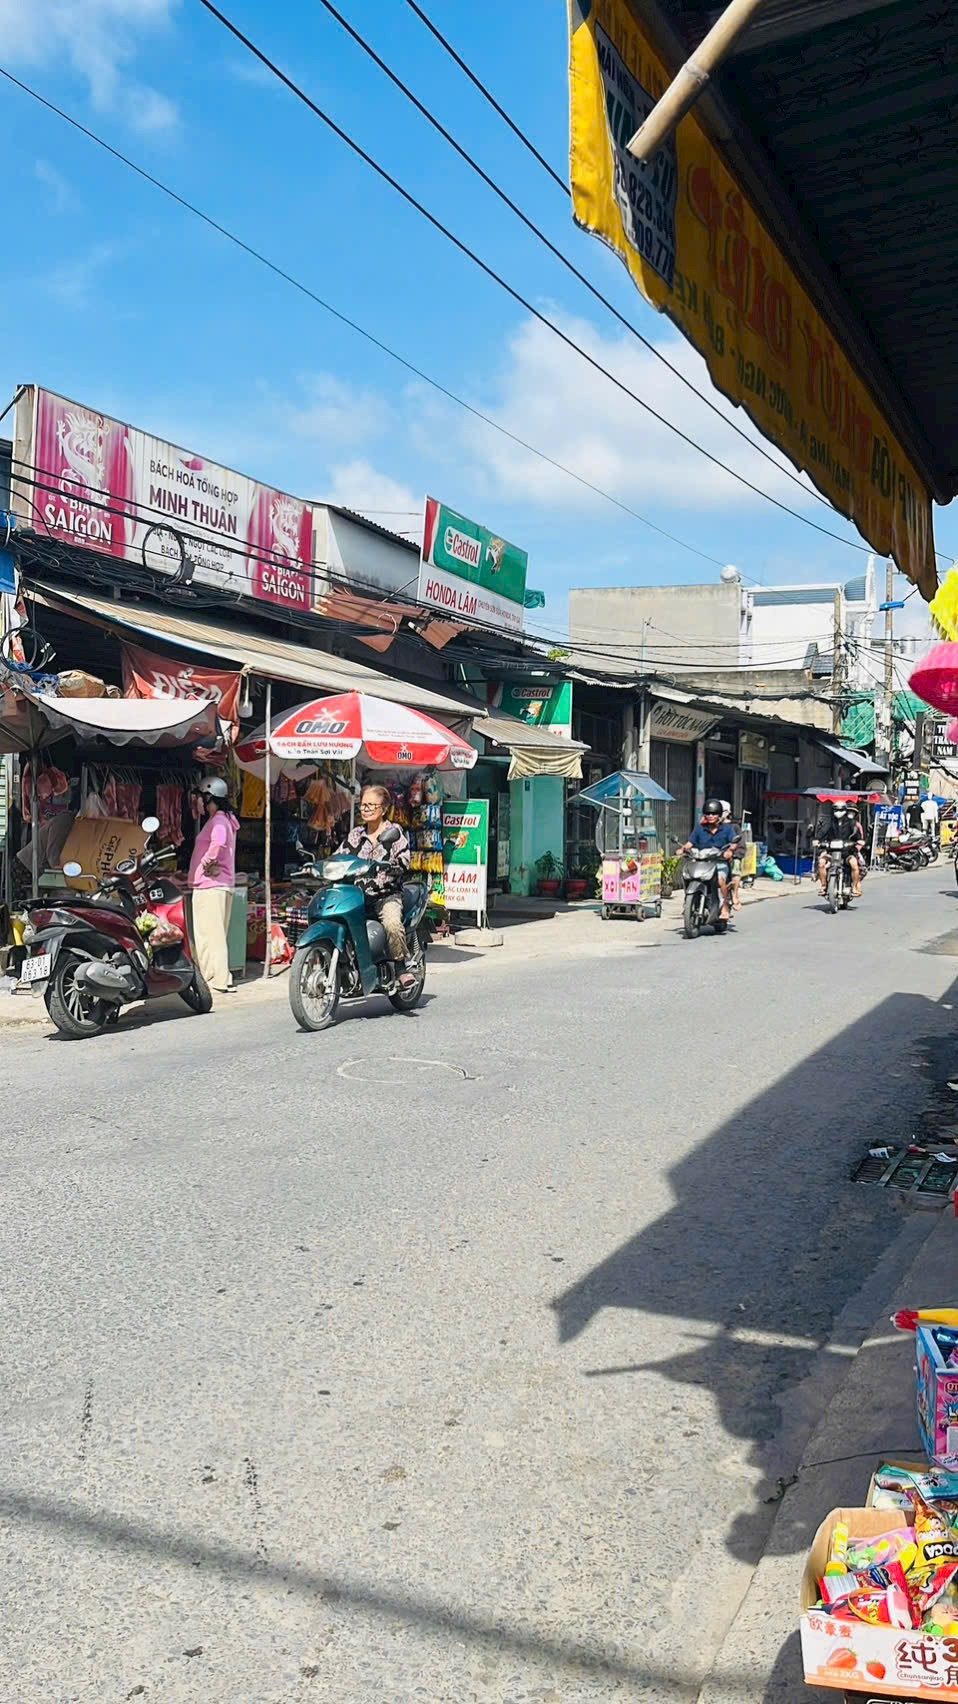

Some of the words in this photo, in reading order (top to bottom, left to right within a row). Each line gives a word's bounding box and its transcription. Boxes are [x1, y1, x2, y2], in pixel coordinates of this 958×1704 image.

[150, 459, 174, 480] BÁCH
[149, 484, 188, 517] MINH
[45, 503, 113, 545] SAIGON
[452, 533, 479, 564] Castrol
[262, 571, 305, 603] SAIGON
[426, 579, 457, 610] HONDA
[458, 591, 478, 616] LÂM
[521, 688, 551, 698] Castrol
[295, 721, 347, 734] OMO
[397, 751, 412, 760] OMO
[937, 746, 953, 756] NAM
[444, 815, 477, 825] Castrol
[452, 870, 478, 885] LÂM
